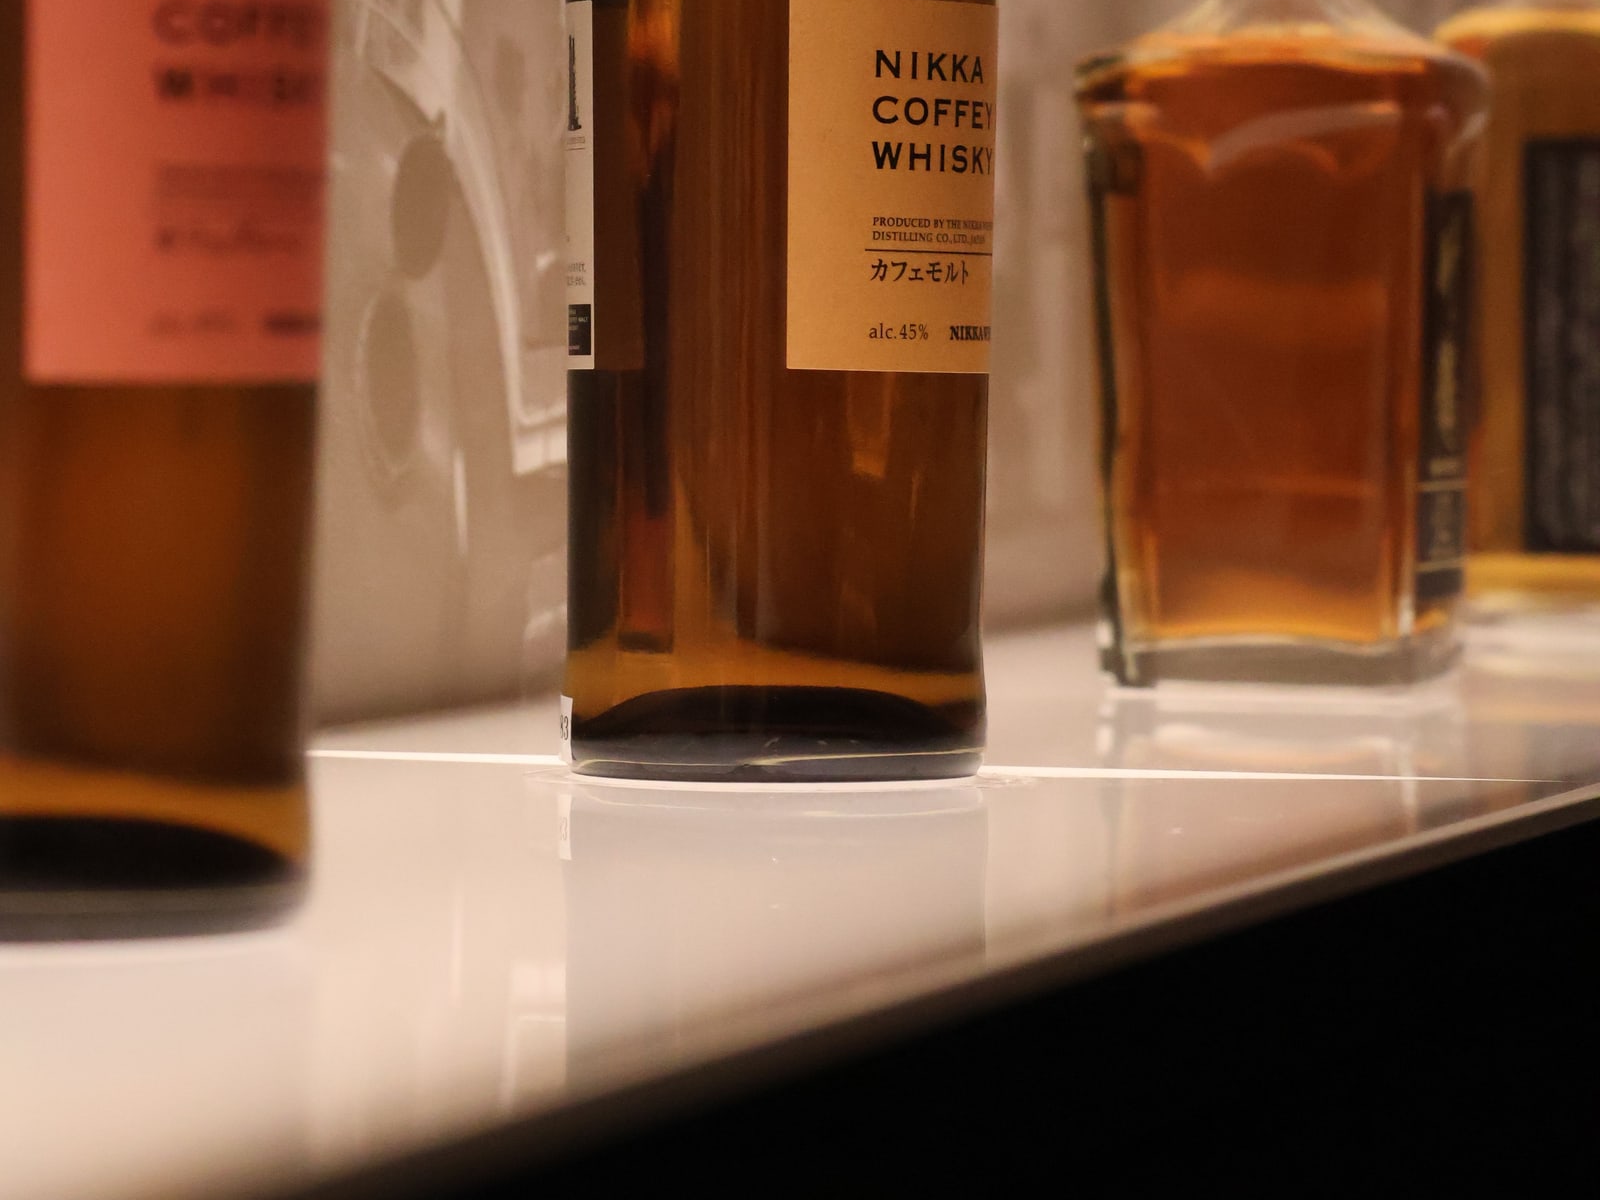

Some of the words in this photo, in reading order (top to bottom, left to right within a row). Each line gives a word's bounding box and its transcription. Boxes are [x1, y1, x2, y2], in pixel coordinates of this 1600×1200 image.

[875, 49, 984, 84] NIKKA
[872, 95, 993, 130] COFFEY
[871, 141, 993, 175] WHISKY
[872, 216, 931, 228] PRODUCED
[933, 218, 945, 229] BY
[872, 230, 933, 243] DISTILLING
[870, 258, 969, 286] カフェモルト
